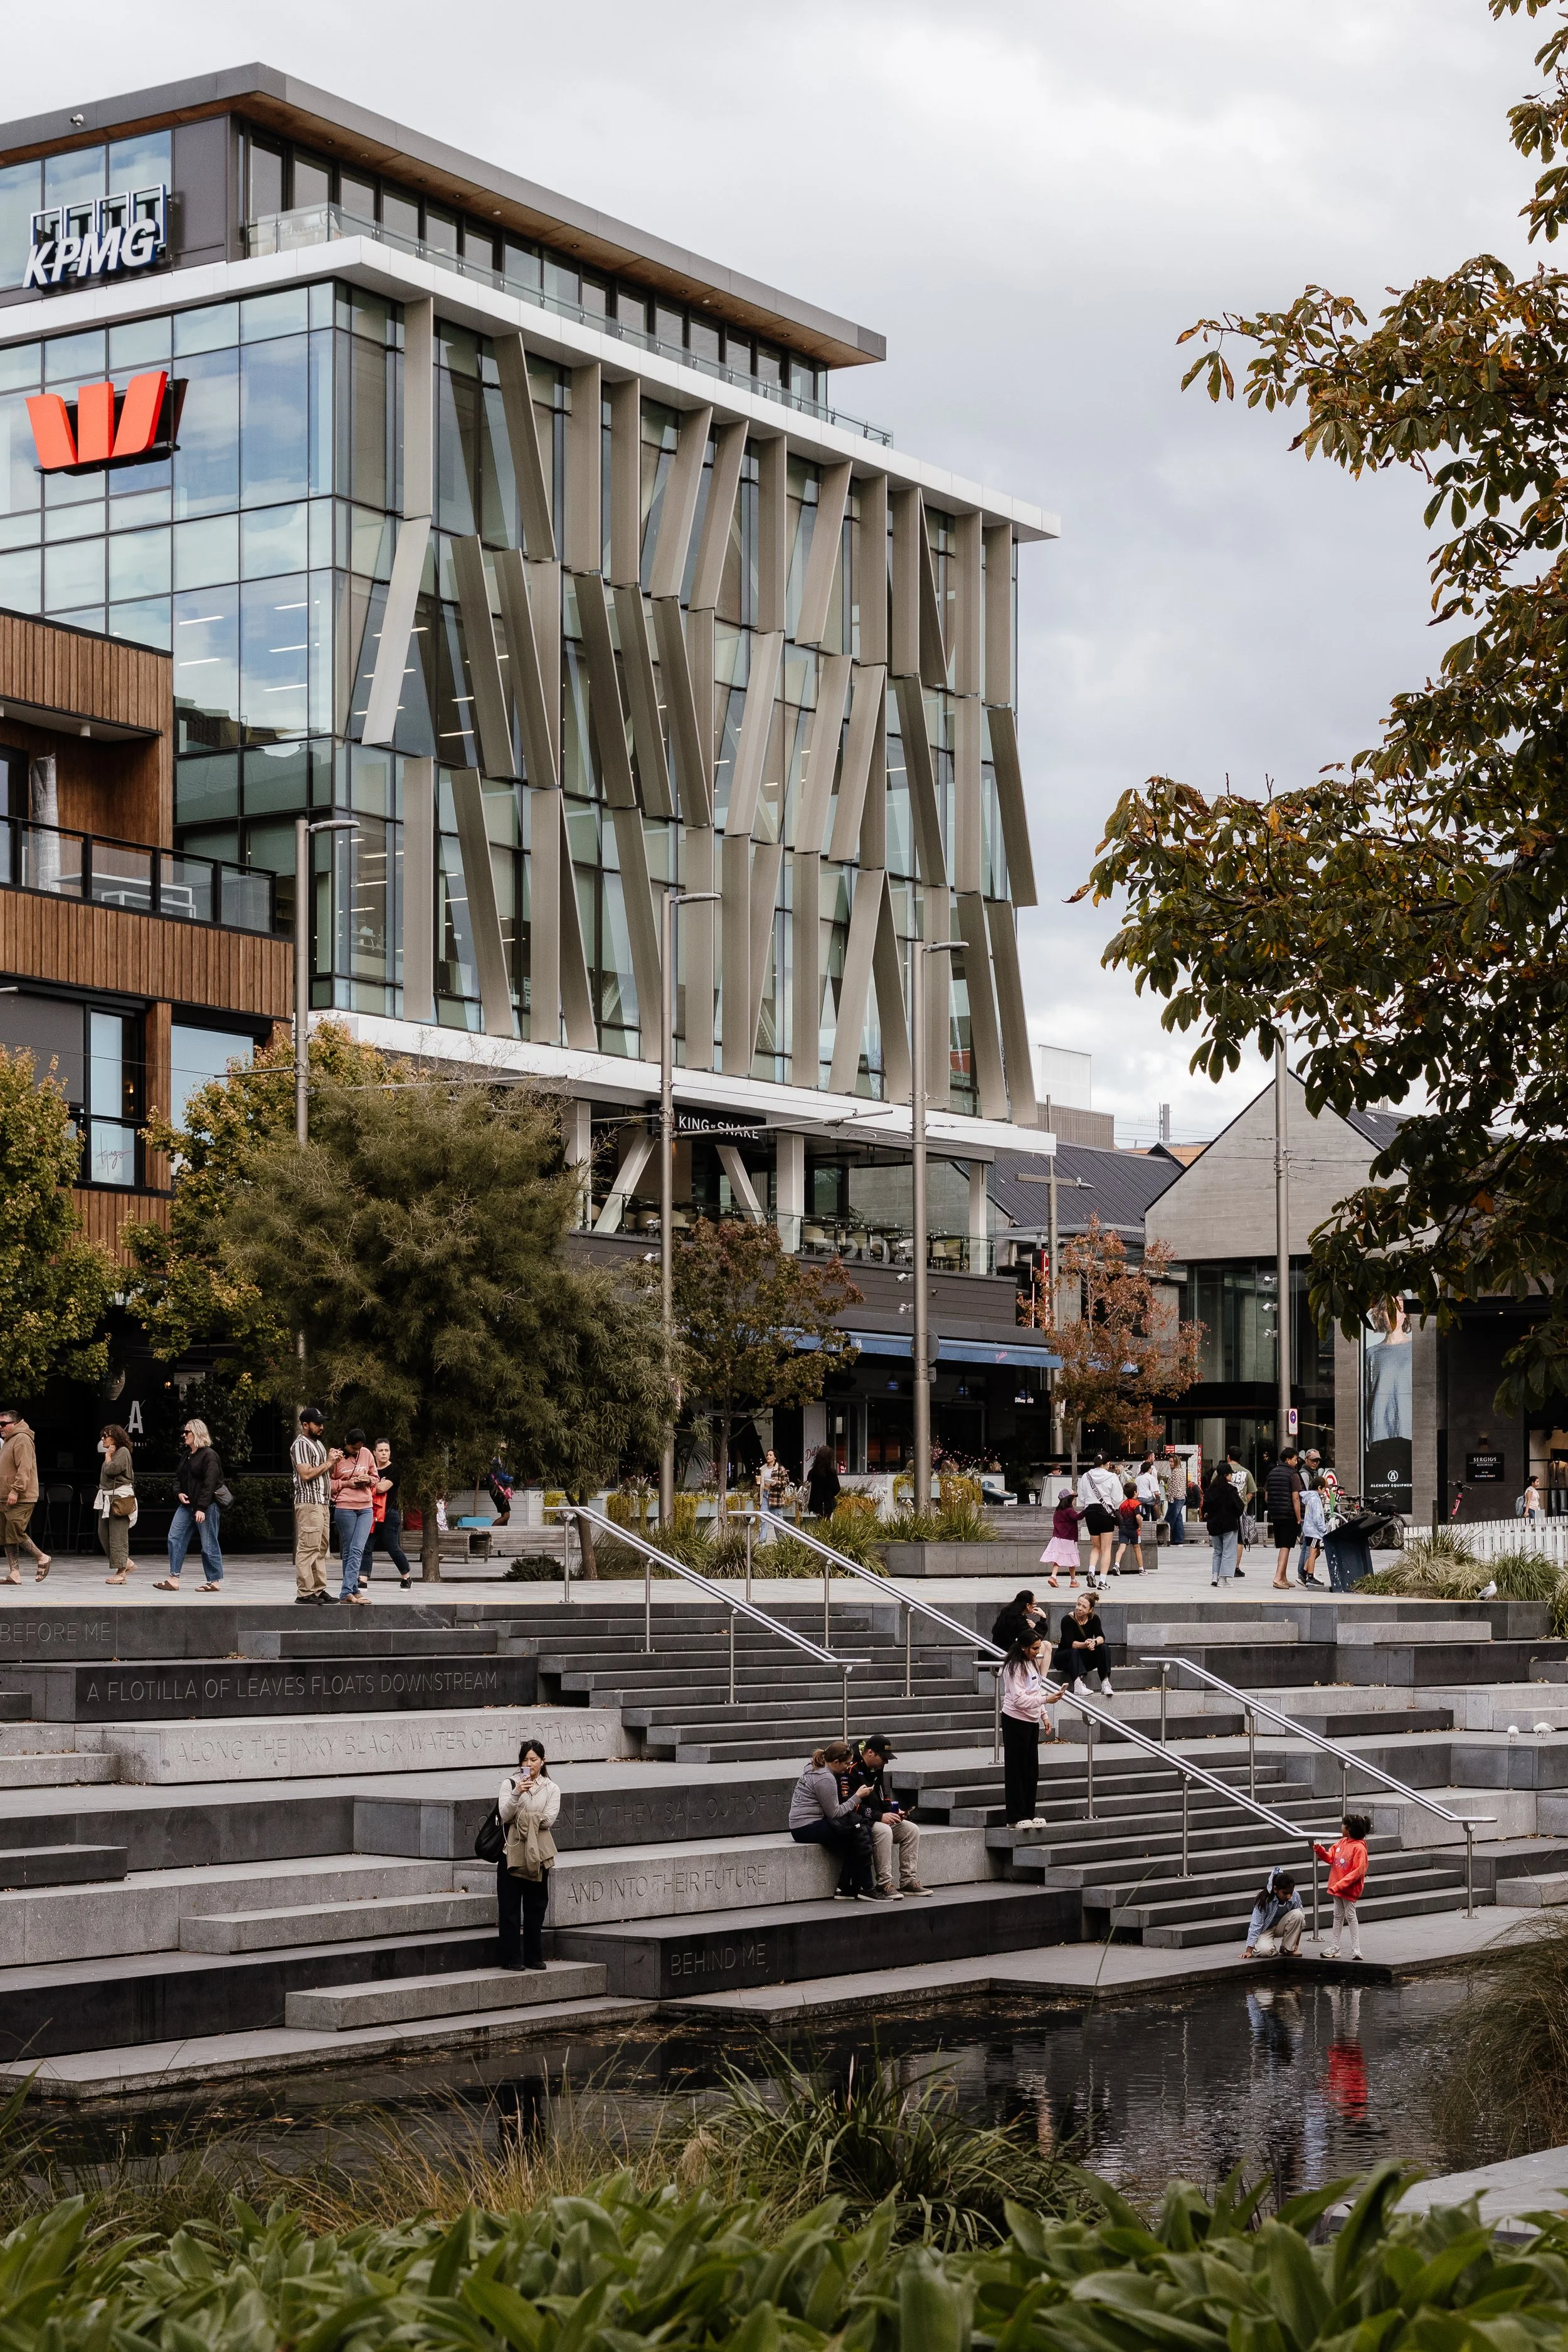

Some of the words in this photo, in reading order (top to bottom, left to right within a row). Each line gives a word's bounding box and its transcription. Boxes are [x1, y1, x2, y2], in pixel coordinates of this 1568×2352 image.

[23, 218, 156, 288] KPMG
[679, 1116, 709, 1130] KING
[95, 1132, 134, 1176] Hugo
[0, 1622, 77, 1642] BEFORE
[85, 1621, 111, 1641] ME
[87, 1682, 100, 1702] A
[108, 1679, 198, 1701] FLOTILLA
[205, 1678, 230, 1698] OF
[238, 1677, 305, 1697] LEAVES
[312, 1675, 374, 1695] FLOATS
[381, 1671, 497, 1693] DOWNSTREAM
[178, 1740, 243, 1762] ALONG
[251, 1738, 288, 1758] THE
[295, 1736, 337, 1756] INKY
[345, 1734, 403, 1756] BLACK
[410, 1730, 467, 1751] WATER
[472, 1729, 493, 1749] OF
[499, 1727, 528, 1747] THE
[612, 1803, 656, 1824] THEY
[706, 1797, 739, 1818] OUT
[745, 1794, 766, 1815] OF
[568, 1880, 604, 1904] AND
[610, 1876, 649, 1900] INTO
[653, 1871, 699, 1894] THEIR
[704, 1865, 766, 1891] FUTURE
[671, 1947, 736, 1976] BEHIND
[743, 1944, 766, 1968] ME
